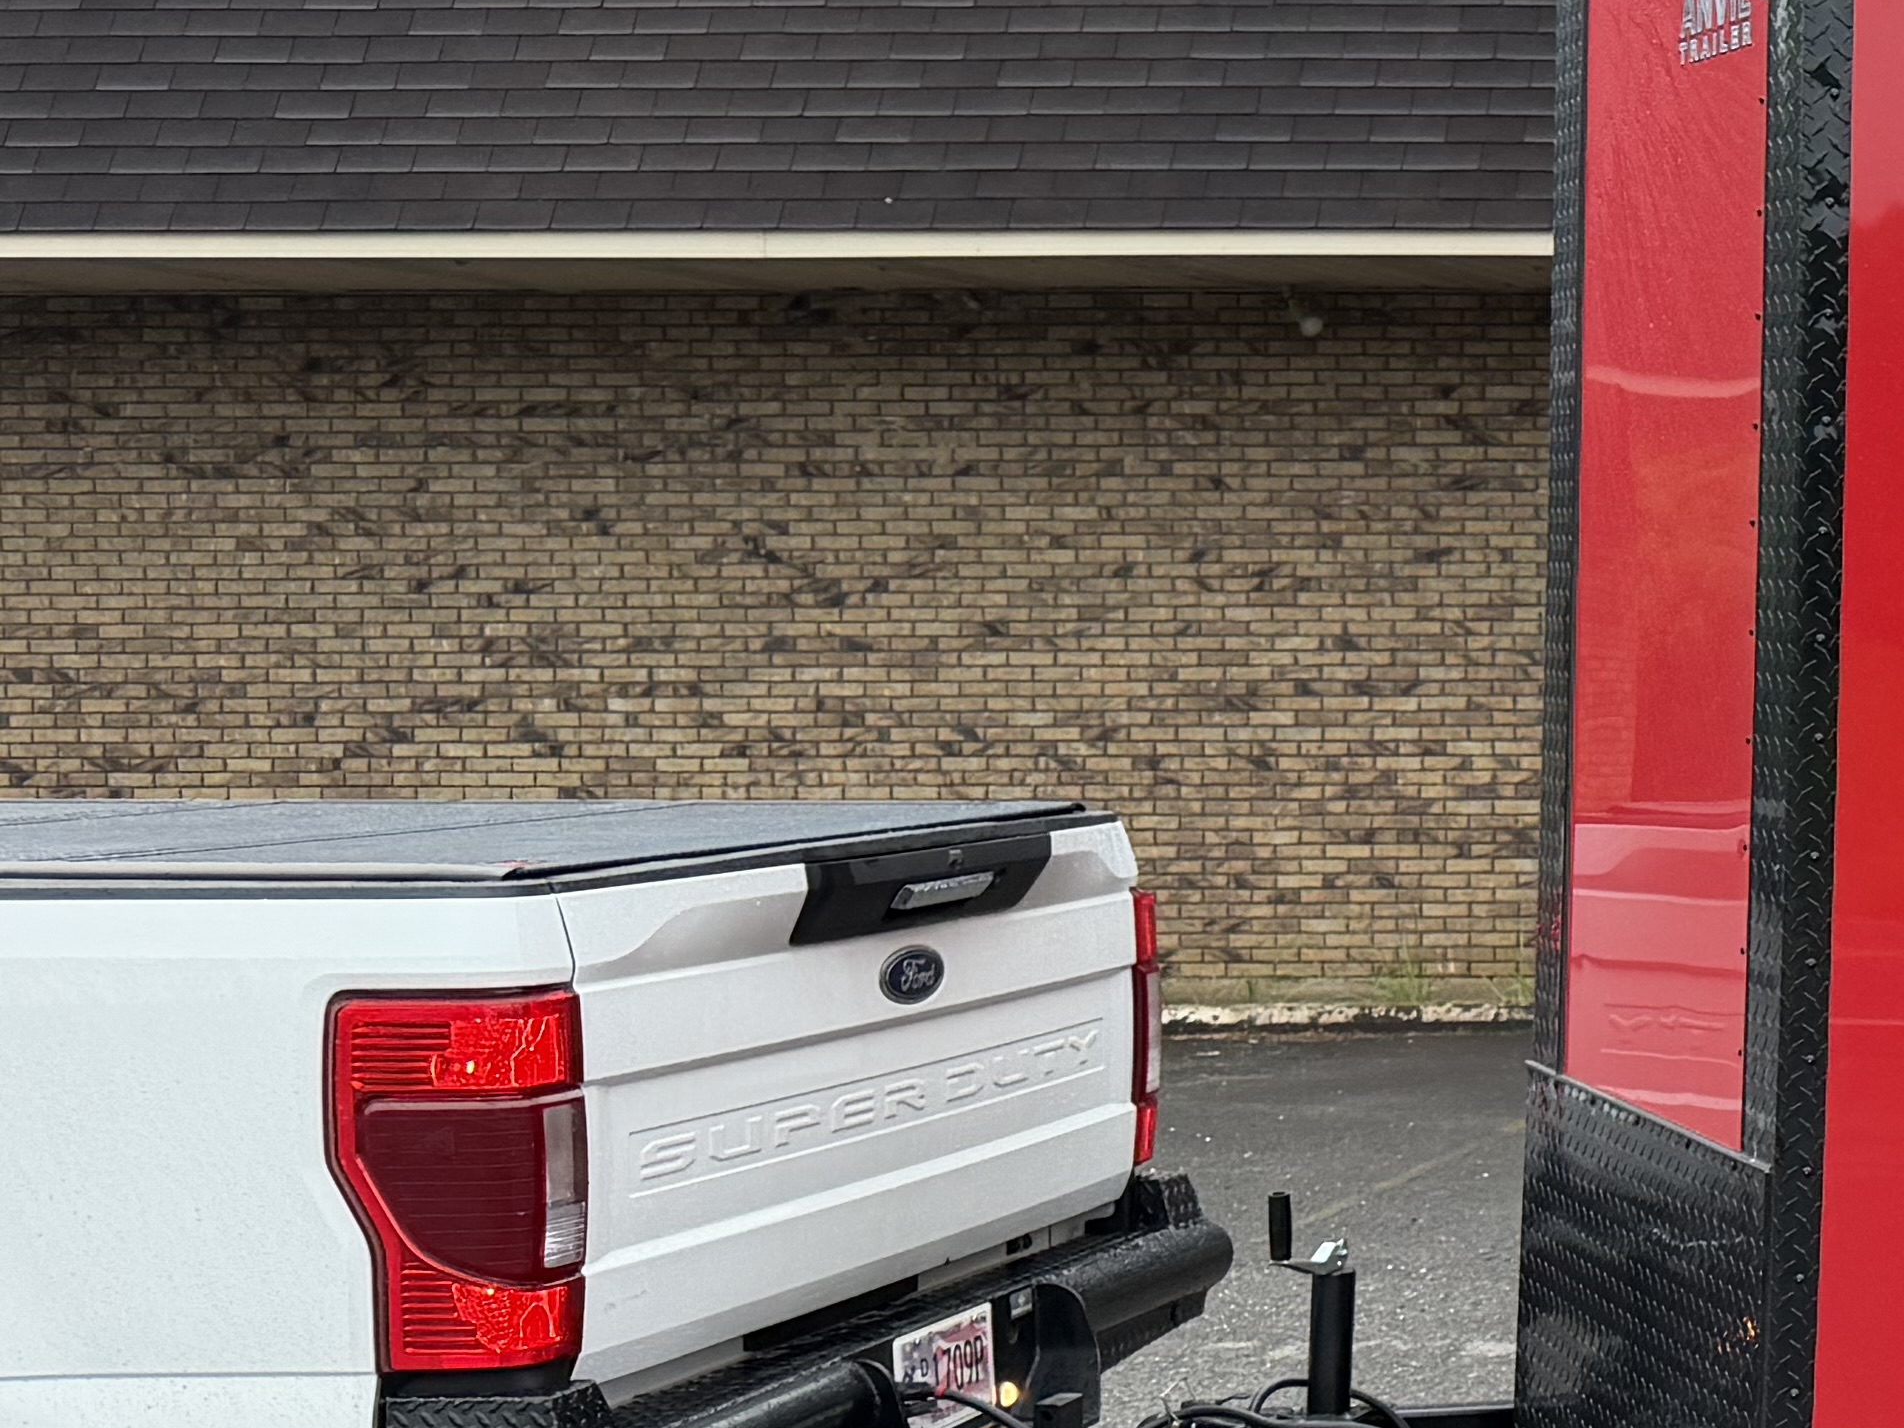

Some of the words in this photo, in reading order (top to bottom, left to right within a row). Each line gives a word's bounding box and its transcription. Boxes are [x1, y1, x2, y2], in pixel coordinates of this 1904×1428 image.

[1679, 20, 1752, 67] TRAILER
[900, 958, 936, 992] Ford
[638, 1079, 927, 1182] SUPER
[944, 1028, 1100, 1104] DUTY
